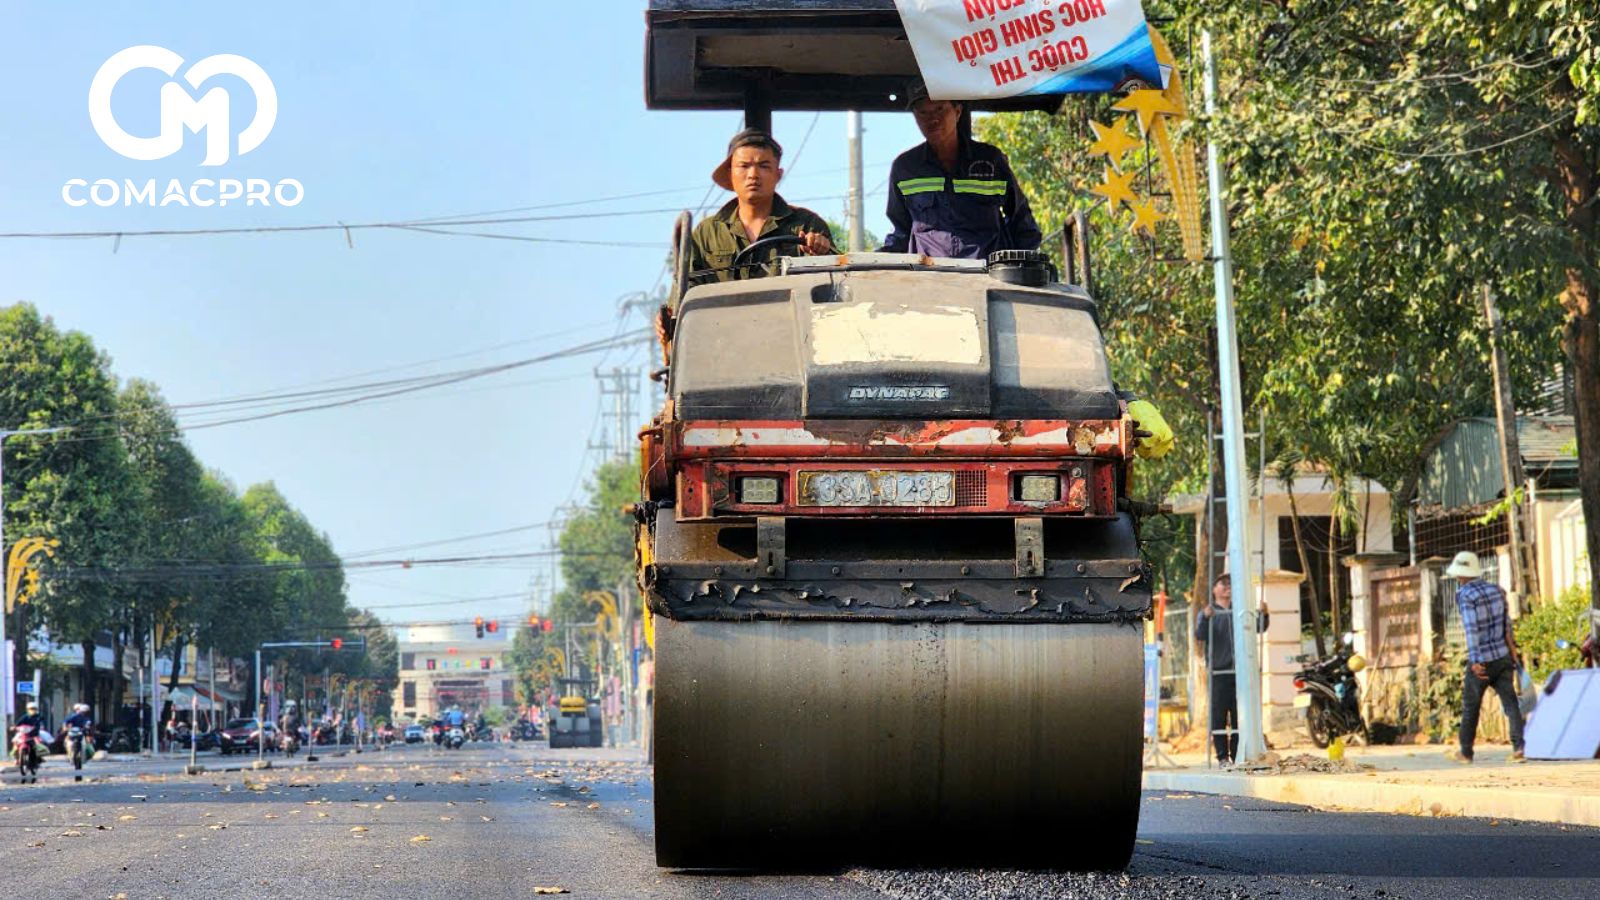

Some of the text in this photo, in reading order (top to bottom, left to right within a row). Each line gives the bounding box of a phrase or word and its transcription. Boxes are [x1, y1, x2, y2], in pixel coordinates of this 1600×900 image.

[951, 28, 999, 67] GIỎI
[1000, 9, 1056, 47] SINH
[989, 35, 1089, 86] CUỘC THI
